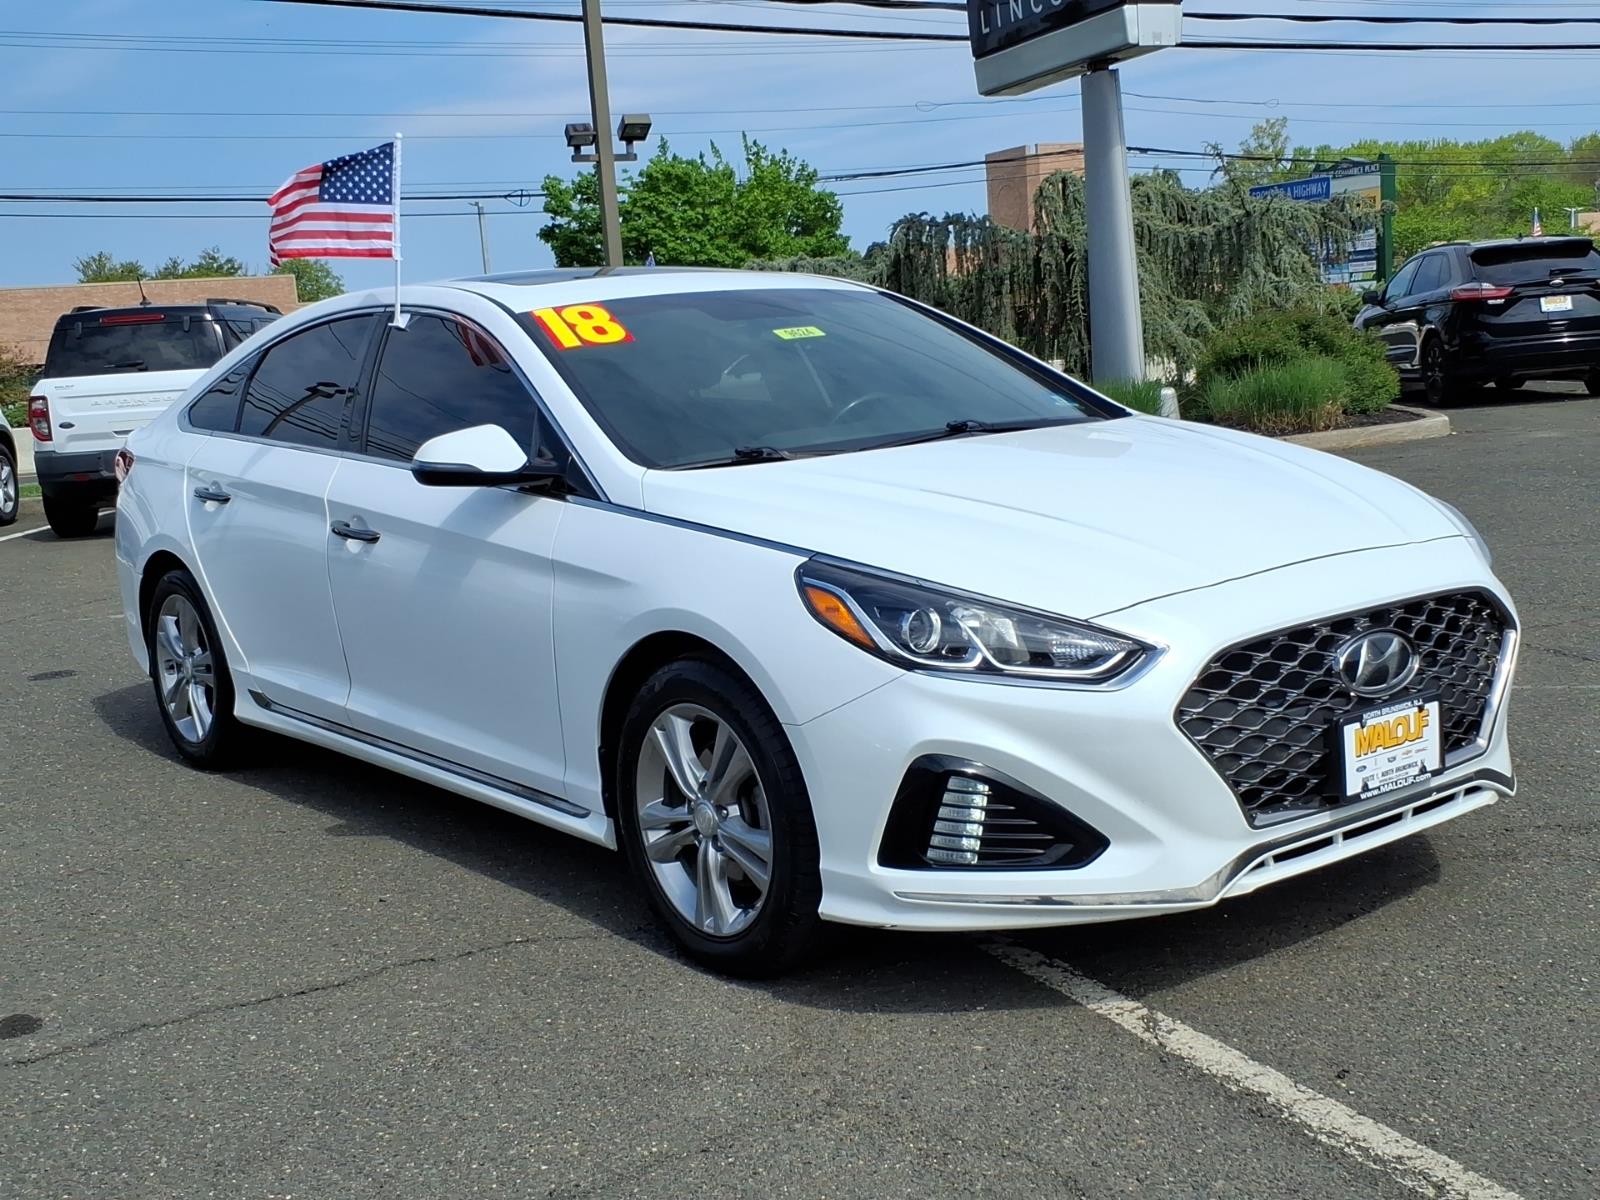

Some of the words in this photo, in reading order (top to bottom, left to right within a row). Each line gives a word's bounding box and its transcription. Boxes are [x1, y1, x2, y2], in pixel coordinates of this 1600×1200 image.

[980, 0, 1062, 34] LINC
[1364, 162, 1380, 172] PLACE
[1286, 188, 1292, 198] A
[1293, 181, 1328, 198] HIGHWAY
[532, 305, 626, 348] 18
[1363, 709, 1381, 720] NORTH
[1355, 708, 1430, 758] MALOUF
[1360, 773, 1432, 800] www.MALOUF.com
